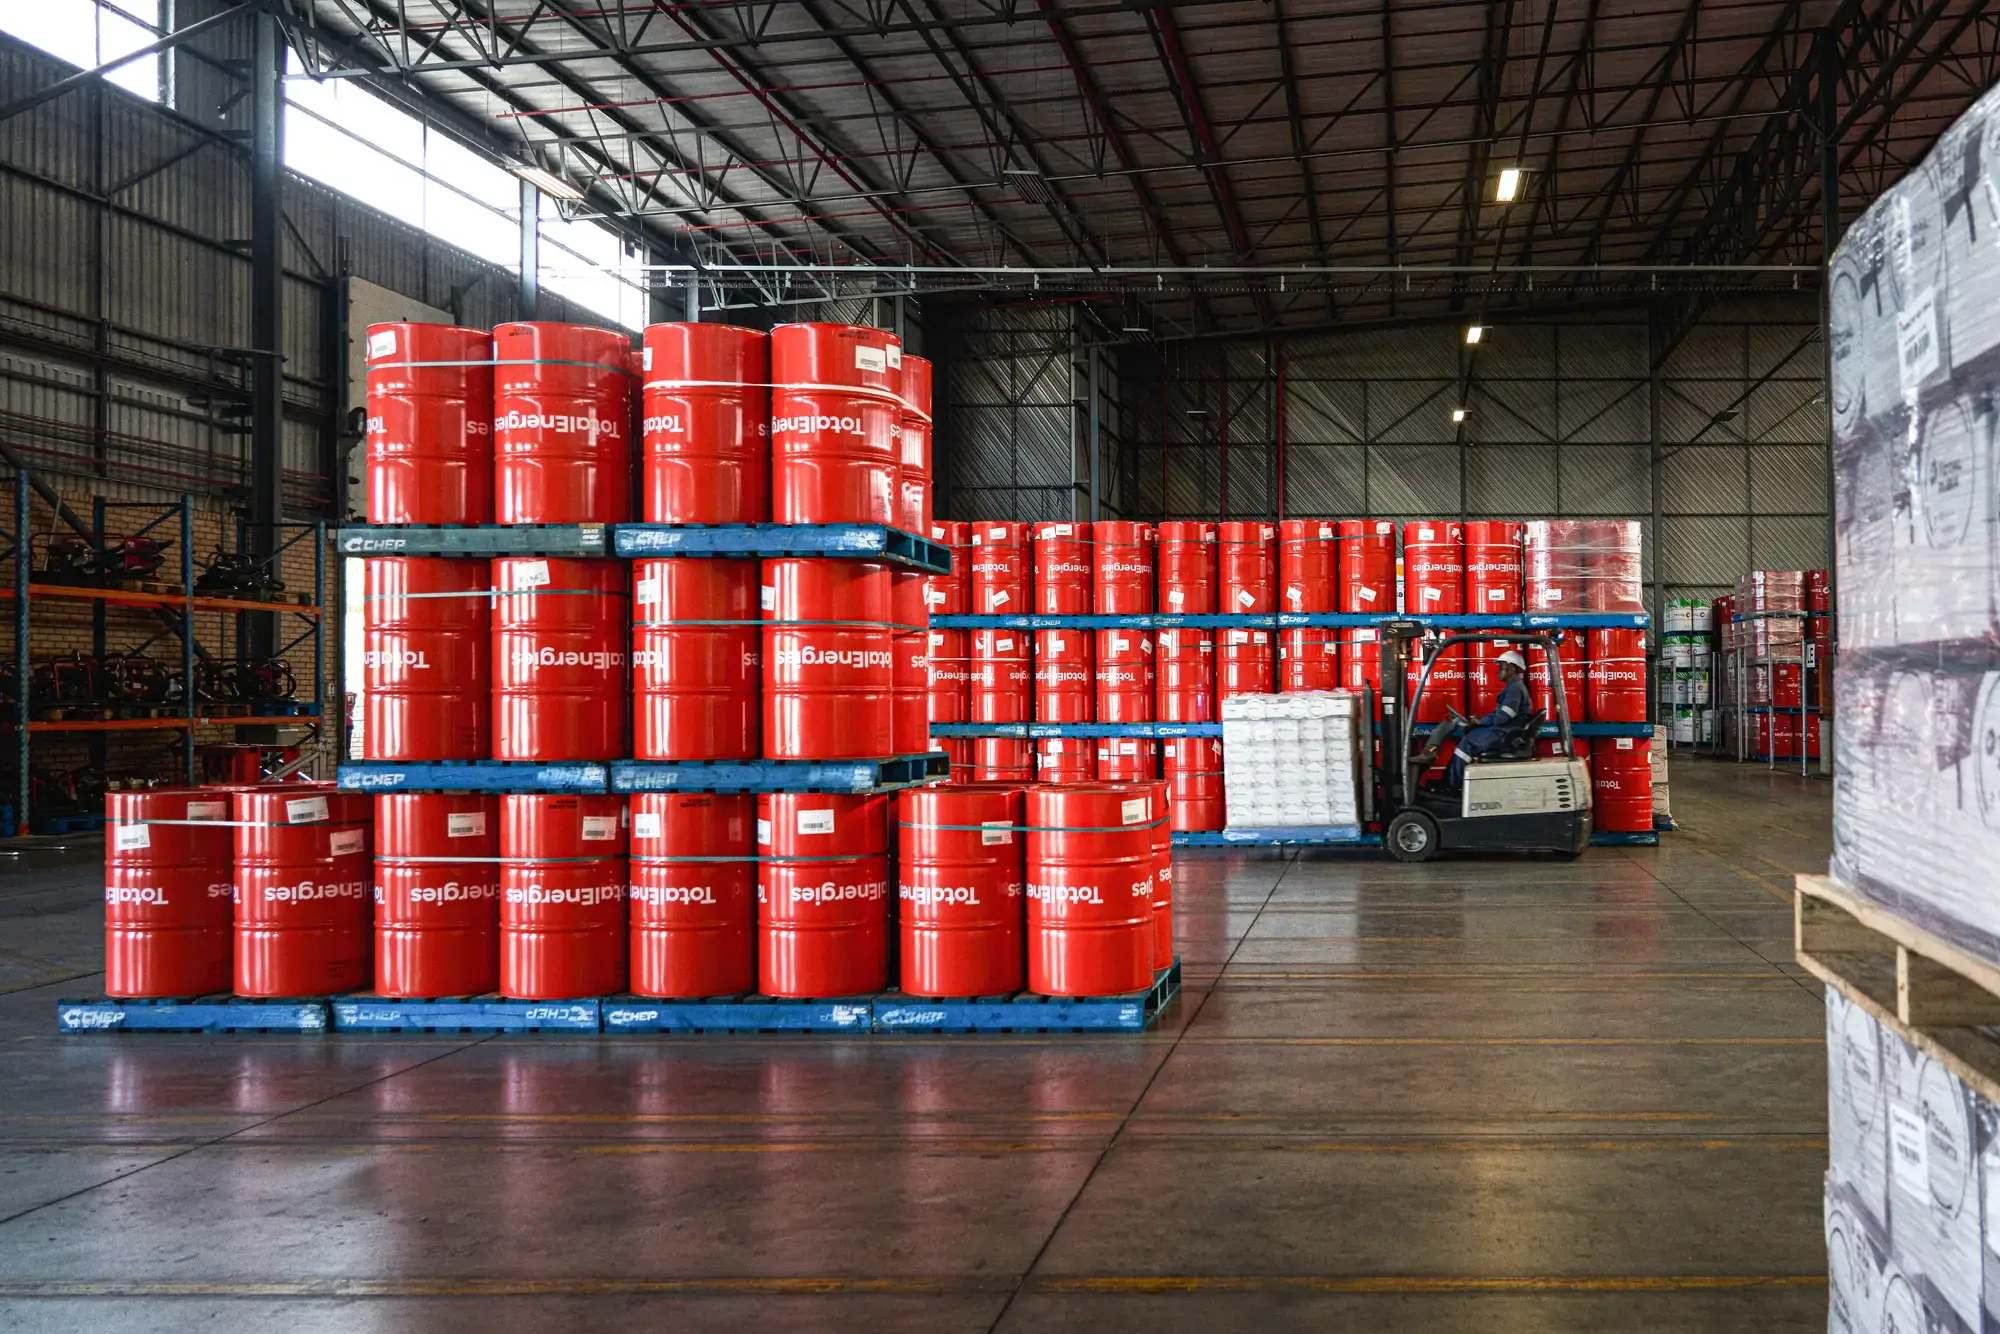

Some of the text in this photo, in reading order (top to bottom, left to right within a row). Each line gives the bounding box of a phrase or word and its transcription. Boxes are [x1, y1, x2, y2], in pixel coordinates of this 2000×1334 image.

[495, 410, 620, 439] TotalEnergies
[362, 539, 407, 551] CHEP
[362, 774, 406, 786] CHEP
[792, 881, 889, 907] alEnergies
[82, 1011, 126, 1027] CHEP
[359, 1009, 402, 1021] CHEP
[525, 1008, 569, 1020] CHEP
[622, 1010, 659, 1021] CHEP
